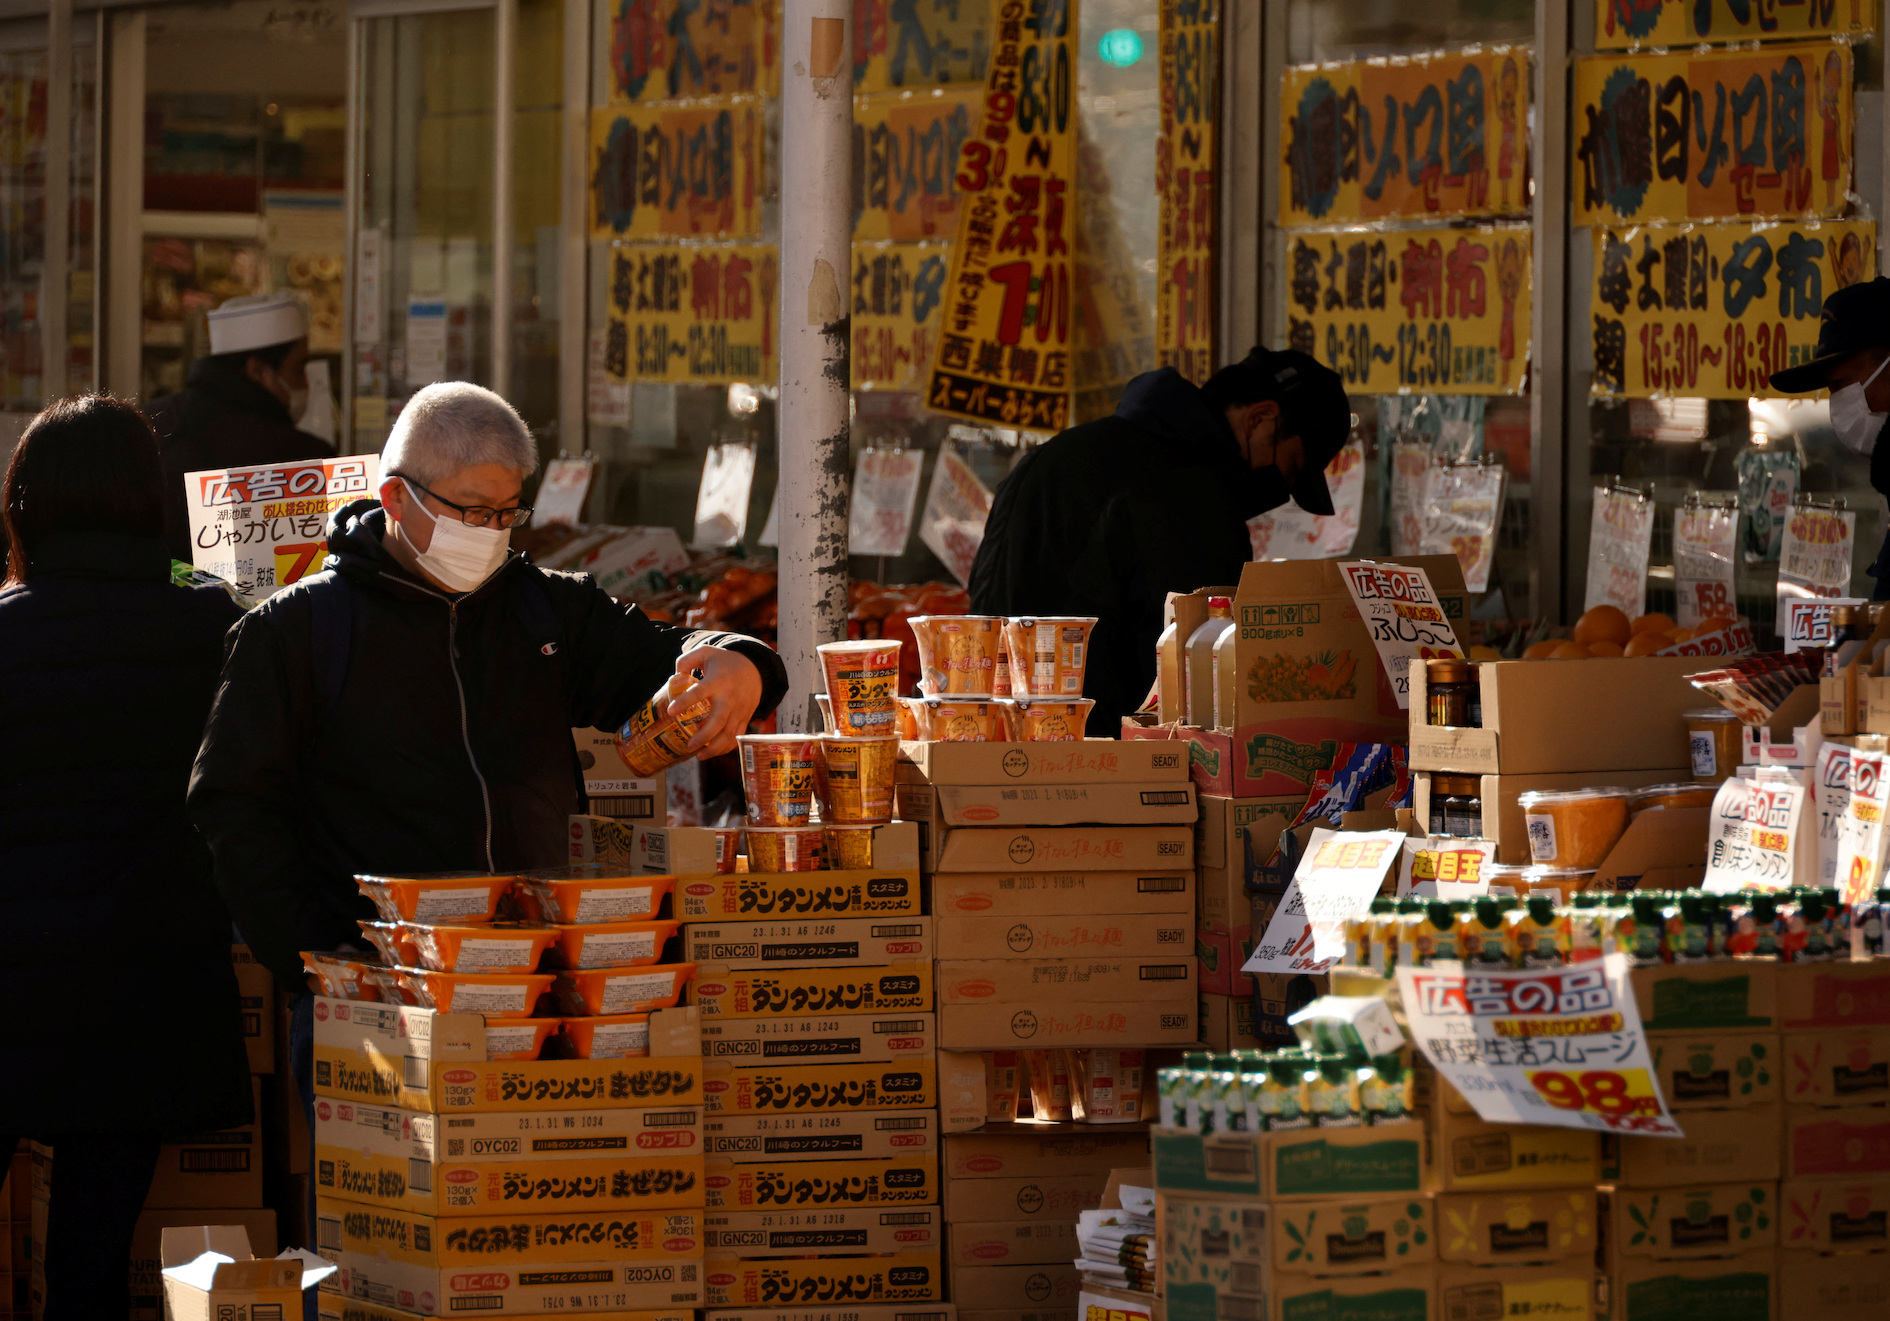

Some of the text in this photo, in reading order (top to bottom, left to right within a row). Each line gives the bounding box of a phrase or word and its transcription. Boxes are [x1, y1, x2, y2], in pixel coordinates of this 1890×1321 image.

[939, 332, 1068, 388] 西巣鴨店
[202, 462, 368, 508] 広告の品
[216, 506, 252, 522] 湖池屋
[256, 567, 275, 587] 税抜
[1350, 567, 1434, 604] 広告の品
[1369, 602, 1392, 615] フジッコ
[1241, 628, 1304, 640] 900gポリ×8
[1370, 616, 1457, 646] ふじっこ
[853, 713, 864, 724] 新
[1153, 755, 1178, 768] SEADY
[587, 782, 638, 790] トリュフと岩塩
[1158, 842, 1184, 855] SEADY
[1313, 840, 1391, 870] 超目玉
[1411, 848, 1483, 884] 超目玉
[739, 880, 767, 889] ニュー
[870, 884, 905, 894] スタミナ
[722, 881, 738, 914] 元祖
[739, 886, 852, 914] タンタンメン
[863, 899, 912, 911] タンタンメン
[753, 925, 836, 937] 23.1.31 A6 1246
[1158, 930, 1184, 943] SEADY
[714, 944, 757, 958] GNC20
[763, 943, 858, 959] 川崎のソウルフード
[1254, 944, 1277, 961] 350g
[752, 980, 780, 989] ニュー
[883, 980, 917, 990] スタミナ
[734, 981, 749, 1012] 元祖
[751, 985, 864, 1014] タンタンメン
[1418, 970, 1614, 1018] 広告の品
[875, 997, 924, 1009] タンタンメン
[756, 1022, 840, 1034] 23.1.31 A6 1243
[1161, 1015, 1188, 1029] SEADY
[1445, 1021, 1478, 1034] カゴメ
[716, 1041, 758, 1054] GNC20
[765, 1040, 859, 1055] 川崎のソウルフード
[502, 1072, 525, 1080] ニュー
[755, 1076, 782, 1085] ニュー
[885, 1077, 919, 1088] スタミナ
[444, 1086, 476, 1096] 130g×
[485, 1073, 499, 1101] 元祖
[502, 1076, 598, 1101] タンタンメン
[609, 1070, 695, 1100] まぜタン
[736, 1077, 751, 1110] 元祖
[754, 1080, 866, 1110] タンタンメン
[877, 1094, 926, 1106] タンタンメン
[444, 1096, 475, 1106] 12個入
[519, 1116, 603, 1130] 23.1.31 W6 1034
[757, 1118, 842, 1130] 23.1.31 A6 1245
[473, 1139, 519, 1153] OYC02
[535, 1137, 625, 1150] 川崎のソウルフード
[639, 1132, 693, 1148] カップ麺
[717, 1138, 759, 1151] GNC20
[766, 1137, 861, 1151] 川崎のソウルフード
[504, 1172, 528, 1180] ニュー
[756, 1172, 784, 1181] ニュー
[888, 1173, 922, 1184] スタミナ
[486, 1172, 500, 1201] 元祖
[503, 1176, 600, 1201] タンタンメン
[611, 1169, 696, 1199] まぜタン
[738, 1173, 754, 1206] 元祖
[446, 1186, 478, 1196] 130g×
[756, 1176, 869, 1206] タンタンメン
[880, 1190, 929, 1202] タンタンメン
[446, 1195, 476, 1206] 12個入
[664, 1215, 695, 1226] 12個入
[762, 1214, 846, 1227] 23.1.31 A6 1318
[543, 1220, 639, 1245] タンタンメン
[640, 1220, 654, 1249] 元祖
[663, 1226, 695, 1236] 130g×
[445, 1222, 531, 1254] まぜタン
[722, 1232, 764, 1245] GNC20
[771, 1231, 866, 1246] 川崎のソウルフード
[614, 1241, 638, 1250] ニュー
[627, 1268, 673, 1282] OYC02
[762, 1269, 789, 1278] ニュー
[892, 1271, 926, 1281] スタミナ
[452, 1274, 507, 1290] カップ麺
[743, 1270, 759, 1304] 元祖
[761, 1274, 873, 1303] タンタンメン
[884, 1288, 933, 1300] タンタンメン
